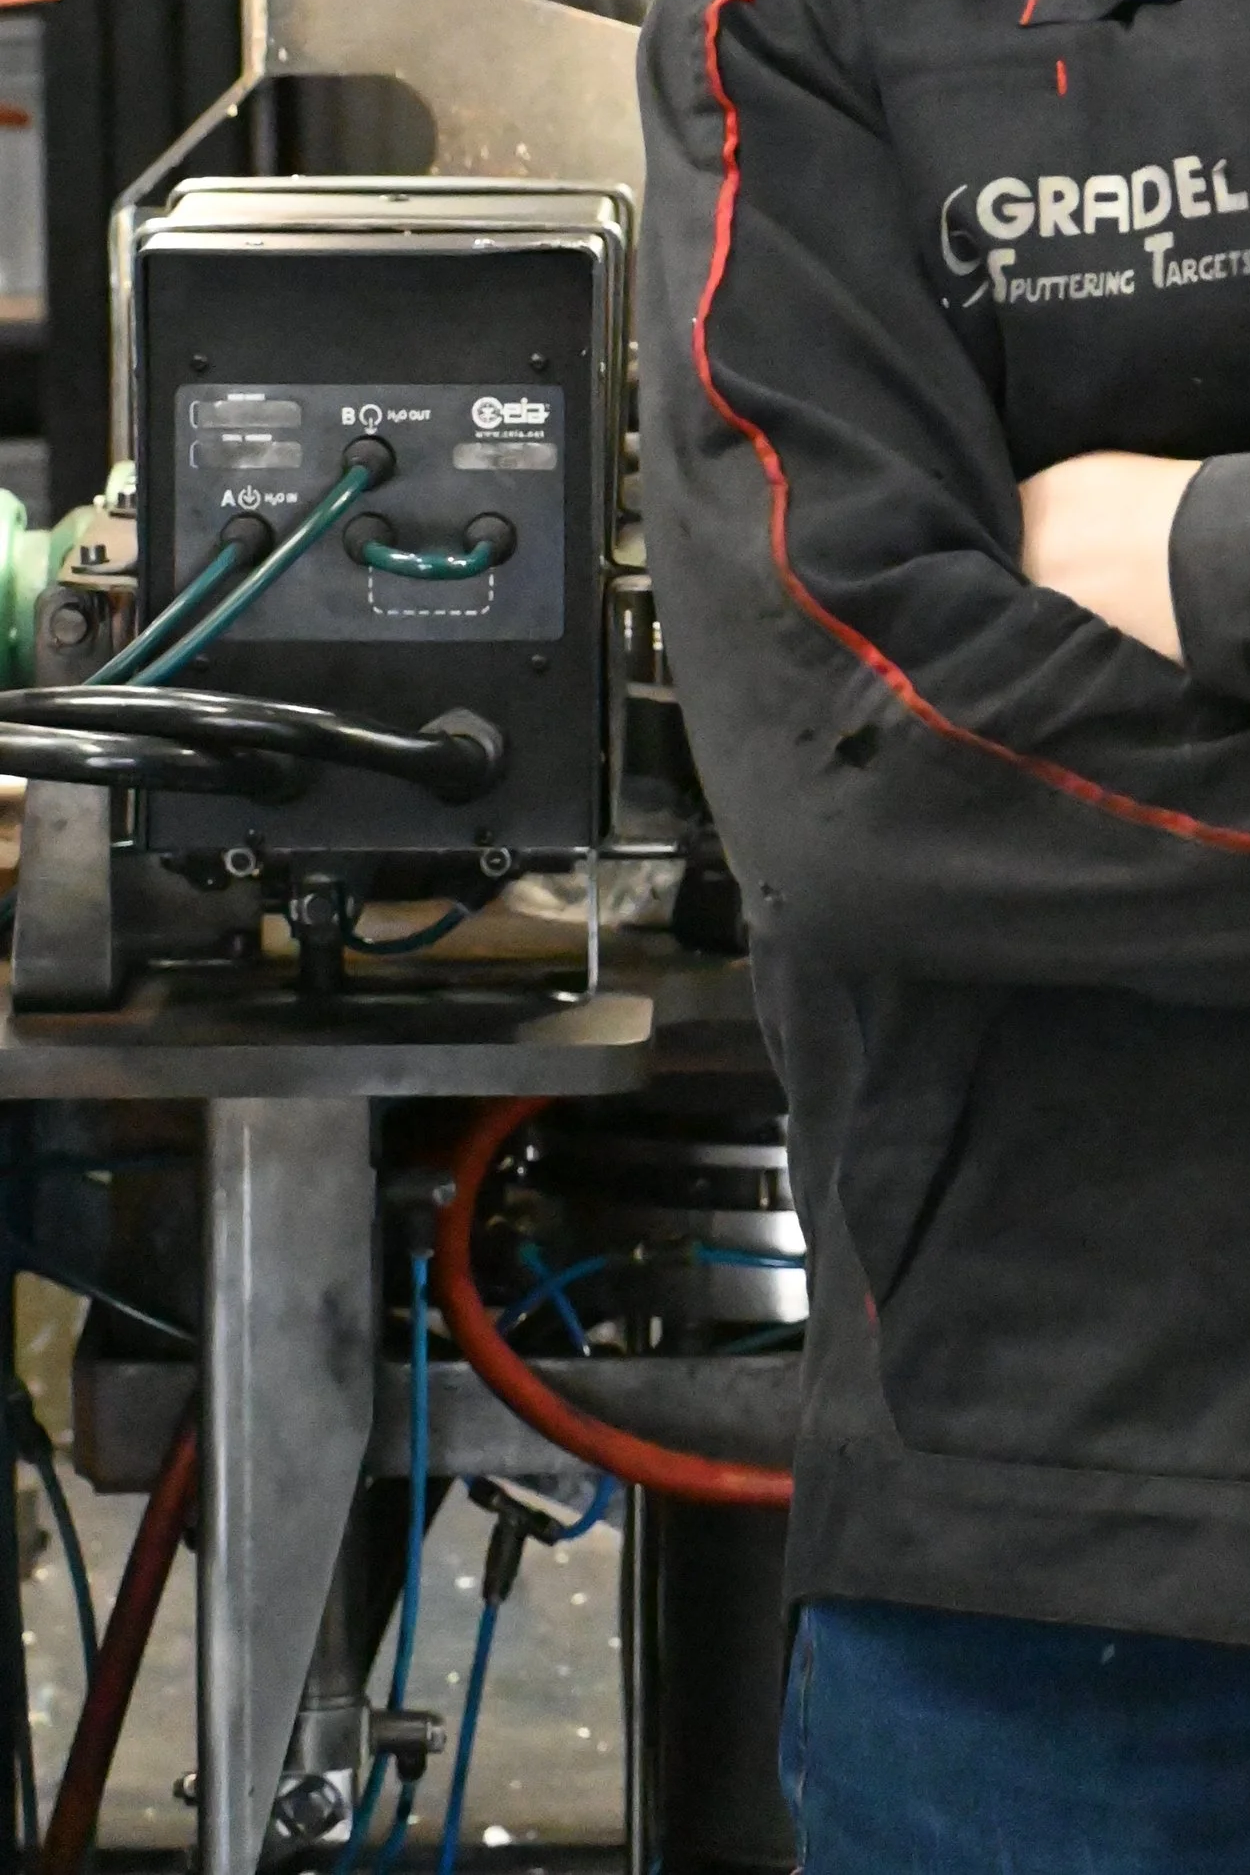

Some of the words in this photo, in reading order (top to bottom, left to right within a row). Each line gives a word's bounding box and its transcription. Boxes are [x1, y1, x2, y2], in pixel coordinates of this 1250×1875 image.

[976, 155, 1249, 240] GRADEL
[341, 407, 356, 425] B
[408, 409, 431, 421] OUT
[221, 489, 236, 507] A
